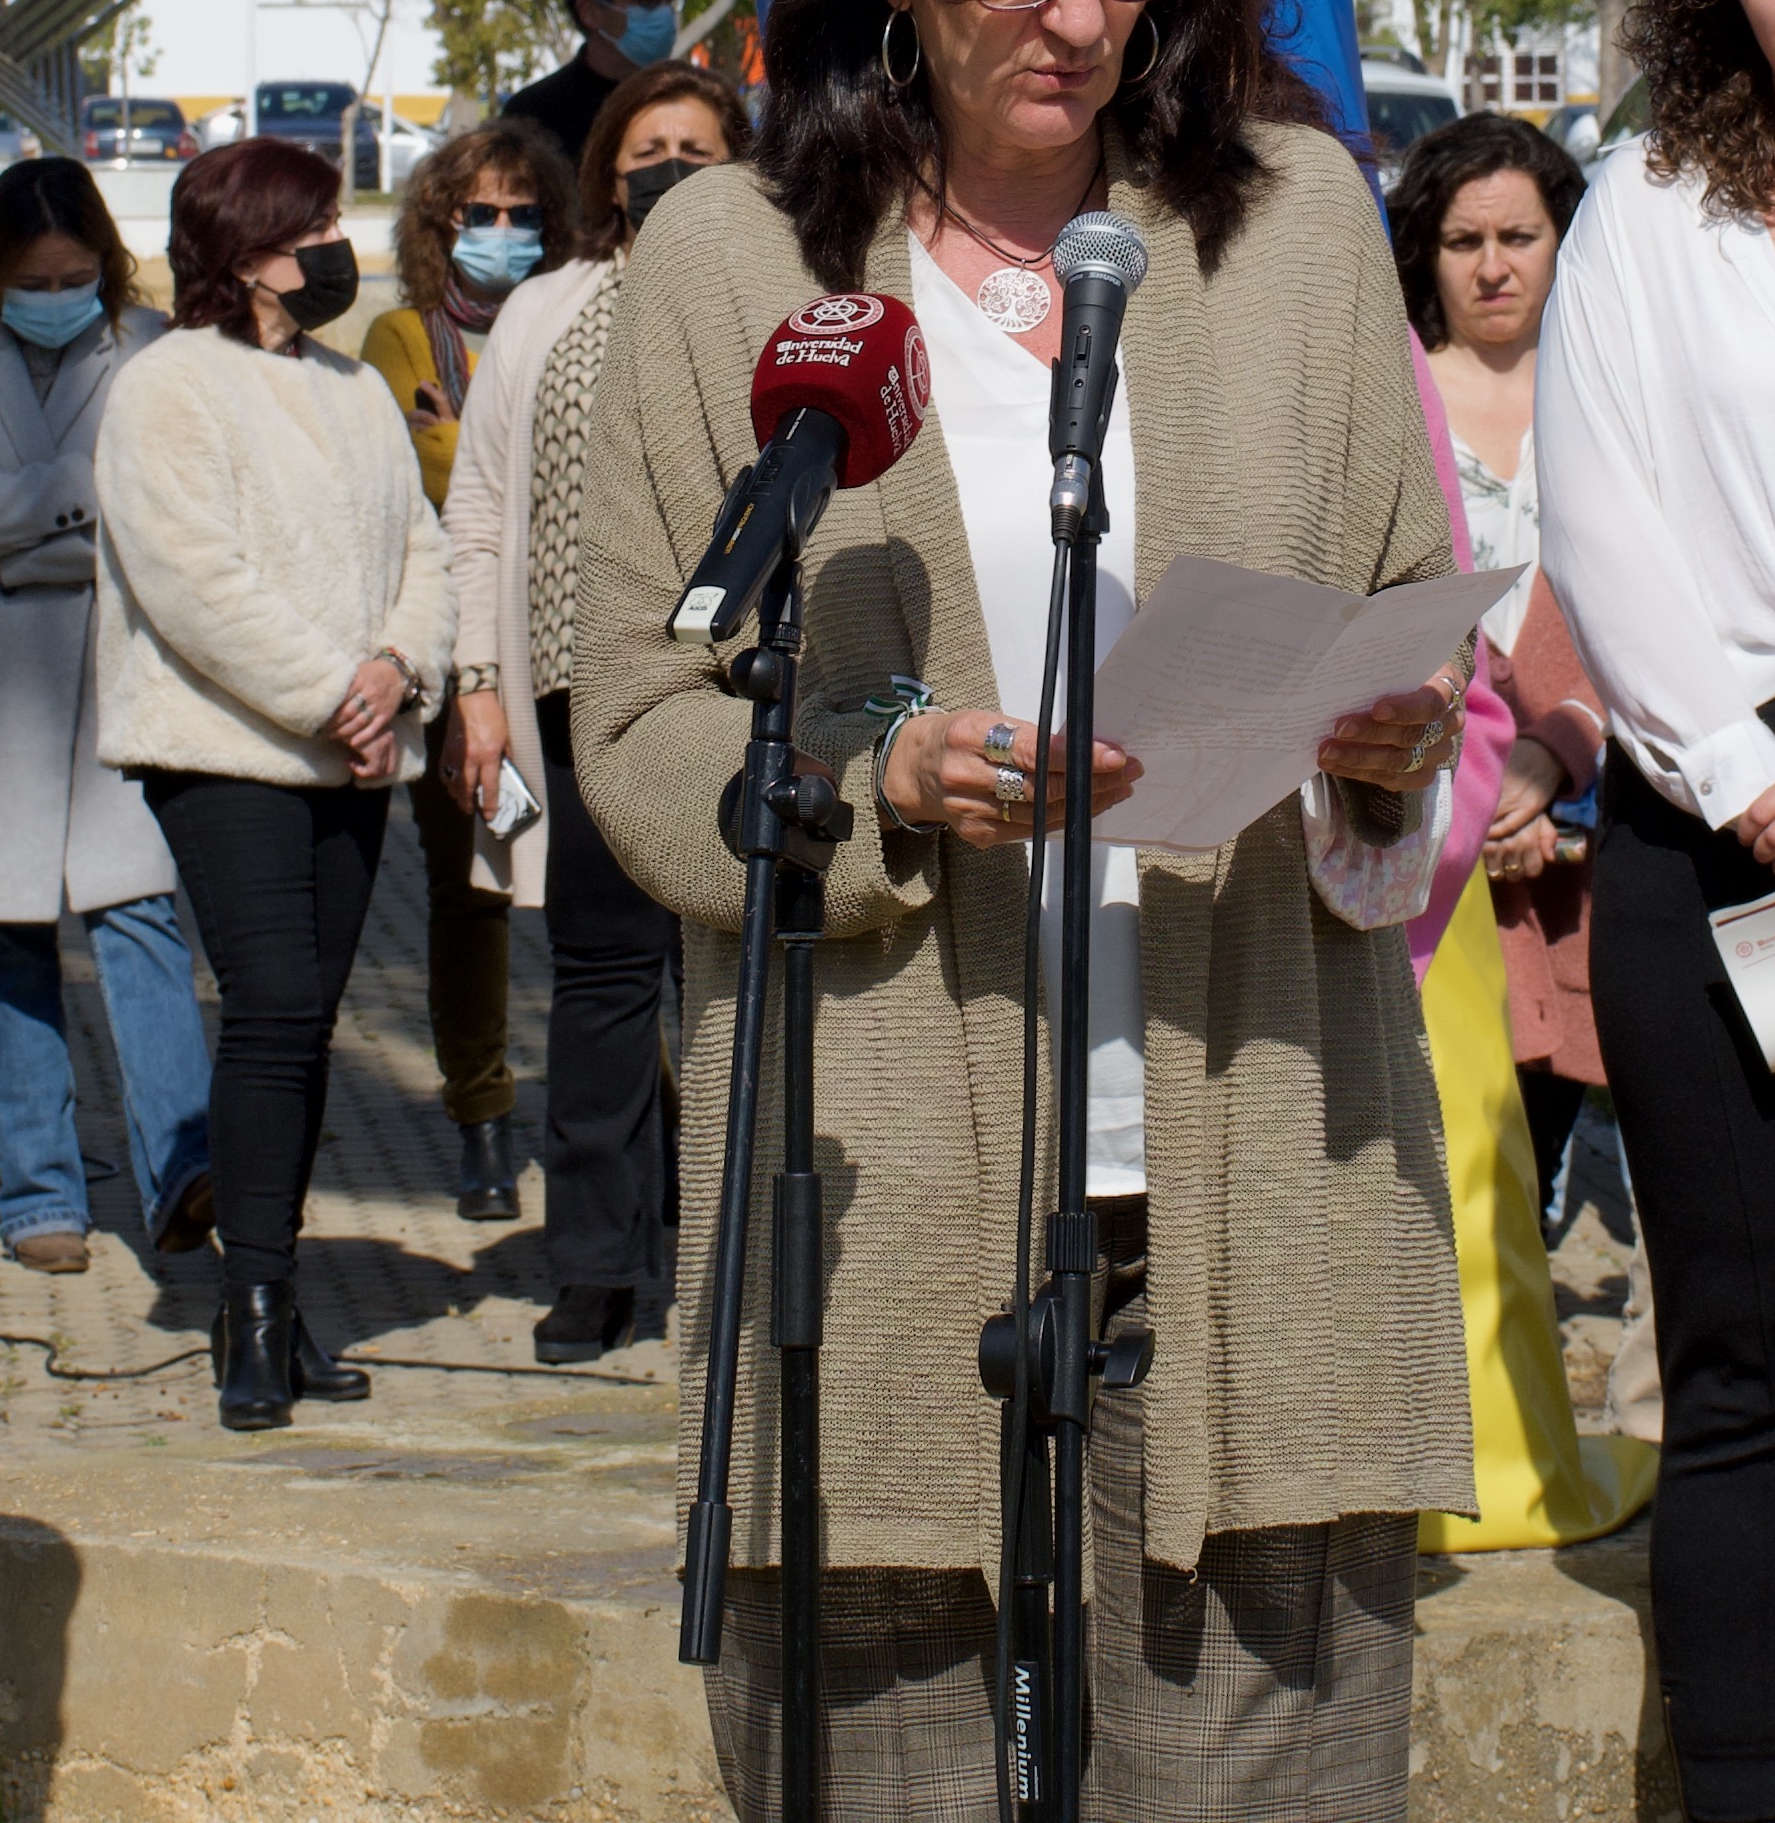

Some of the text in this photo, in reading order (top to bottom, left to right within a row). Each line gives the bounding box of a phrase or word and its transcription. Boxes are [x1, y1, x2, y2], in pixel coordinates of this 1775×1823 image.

[776, 337, 864, 355] Universidad
[776, 349, 851, 367] de Huelva
[1014, 1664, 1033, 1801] Millenium
